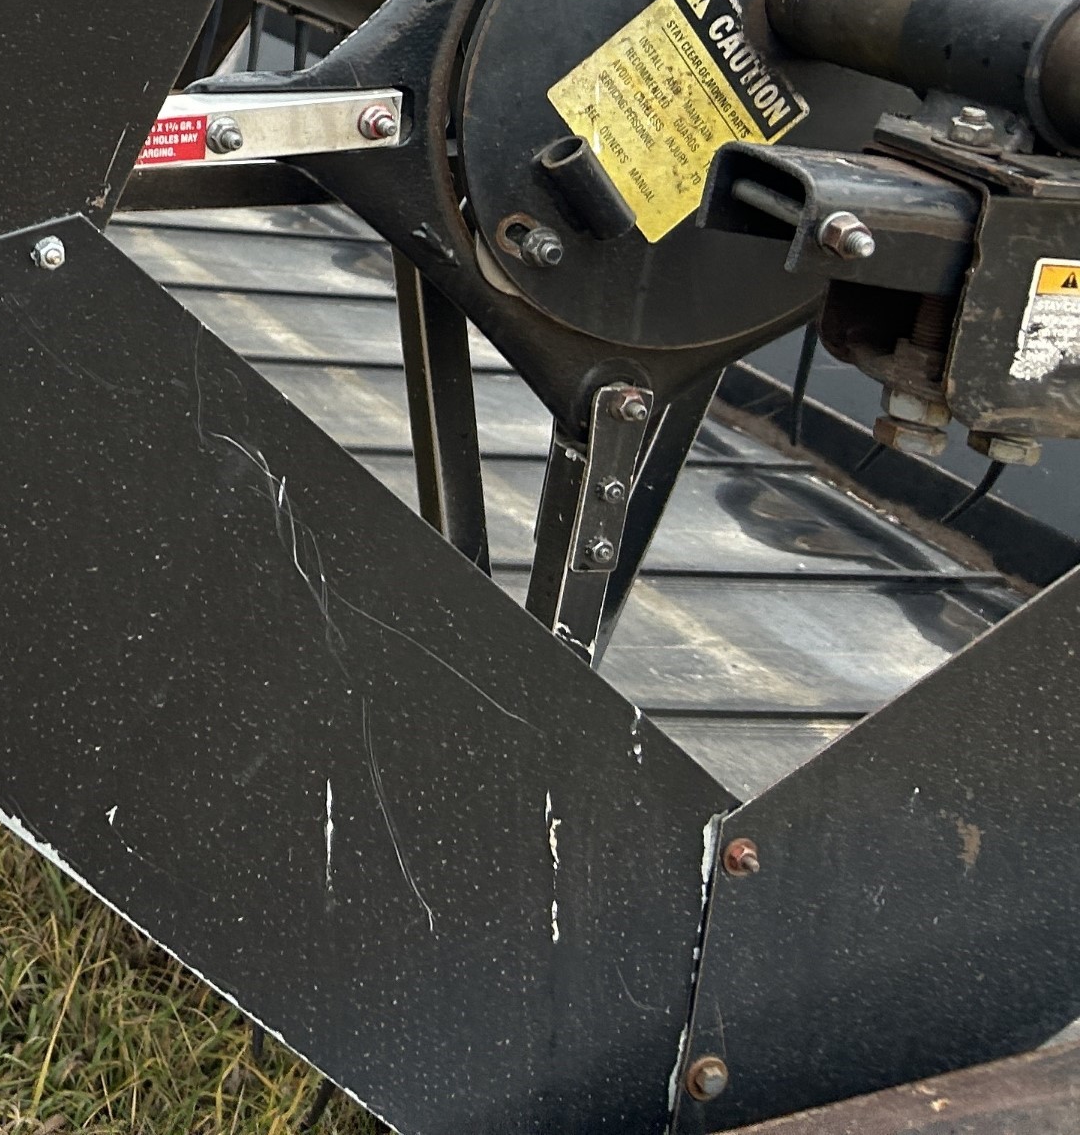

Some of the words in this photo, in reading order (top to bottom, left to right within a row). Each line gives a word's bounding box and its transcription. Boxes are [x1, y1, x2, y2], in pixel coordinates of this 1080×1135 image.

[599, 70, 628, 110] SERVICING
[624, 107, 655, 152] PERSONNEL
[611, 59, 633, 86] AVOID
[633, 91, 664, 132] CARELESS
[665, 136, 689, 166] INJURY
[691, 171, 702, 185] TO
[626, 47, 670, 109] RECOMMENDED
[673, 118, 700, 152] GUARDS
[639, 36, 664, 71] INSTALL
[665, 76, 682, 95] AND
[683, 99, 713, 142] MAINTAIN
[666, 20, 686, 42] STAY
[681, 39, 702, 70] CLEAR
[705, 77, 732, 112] MOVING
[728, 107, 751, 138] PARTS
[708, 14, 791, 127] CAUTION
[152, 134, 179, 145] HOLES
[180, 133, 199, 144] MAY
[585, 104, 600, 123] SEE
[600, 125, 629, 164] OWNER'S
[629, 167, 655, 203] MANUAL
